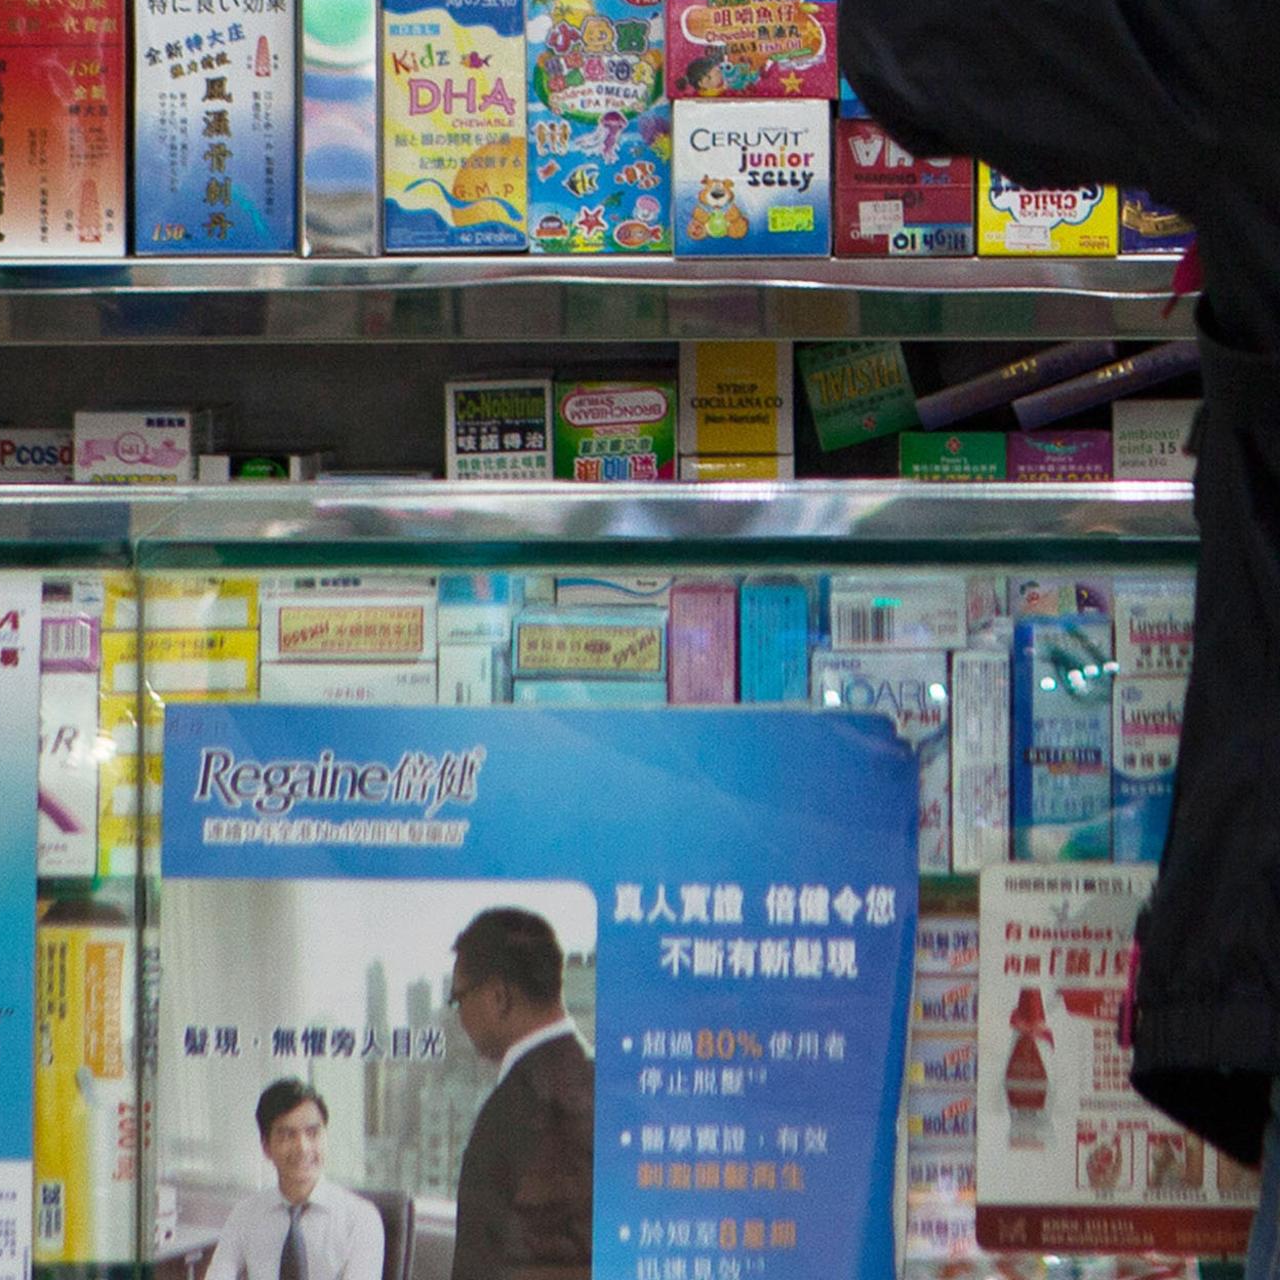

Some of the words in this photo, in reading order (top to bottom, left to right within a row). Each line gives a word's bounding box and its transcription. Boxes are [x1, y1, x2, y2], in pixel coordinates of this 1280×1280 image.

[392, 44, 451, 75] Kidz
[408, 77, 517, 118] DHA
[689, 127, 806, 153] CERUVIT
